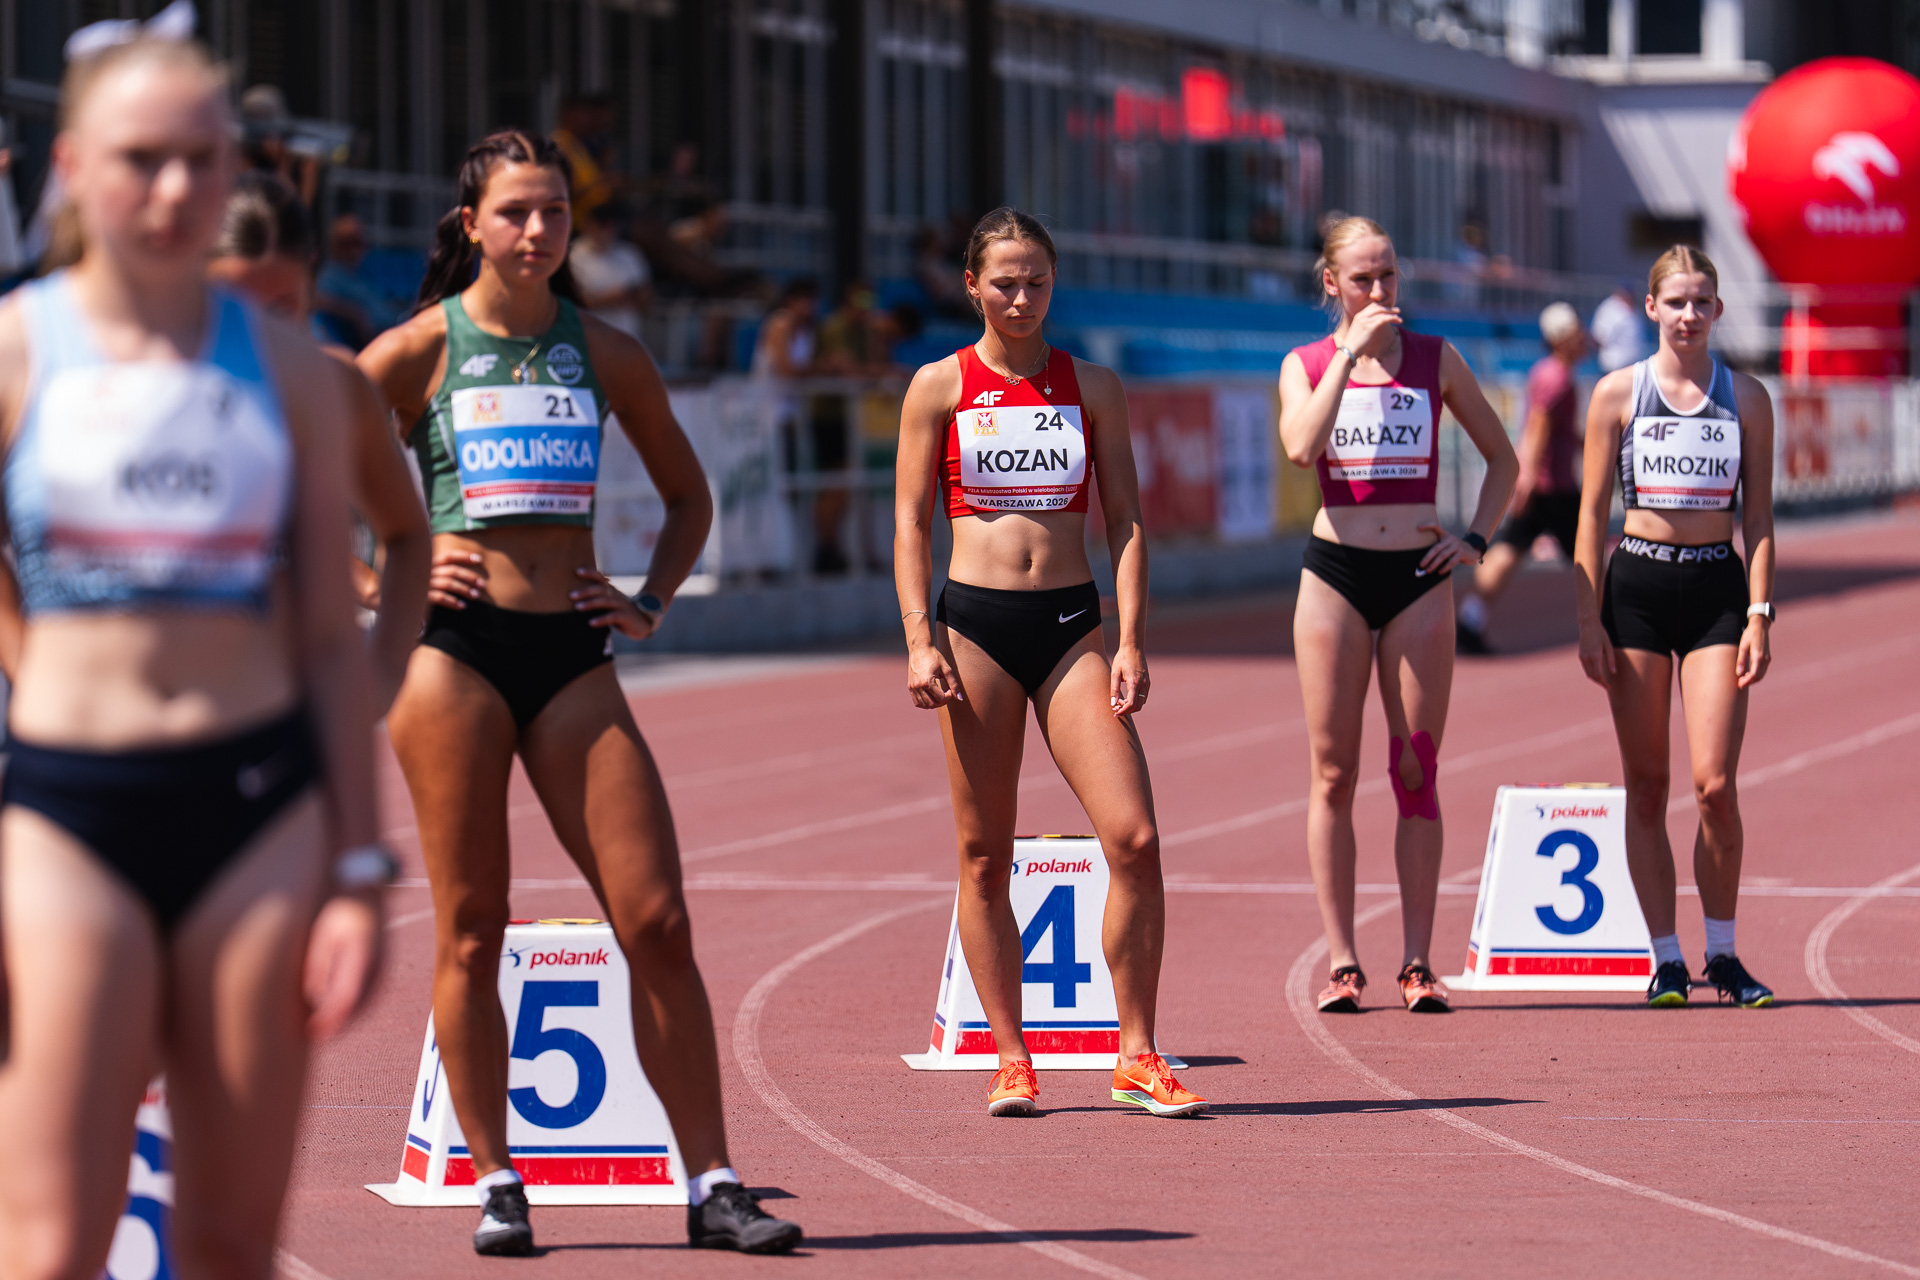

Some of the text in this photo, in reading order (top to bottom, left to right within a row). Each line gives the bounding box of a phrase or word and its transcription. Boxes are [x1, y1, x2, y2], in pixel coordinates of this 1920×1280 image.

[459, 353, 499, 377] 4F
[545, 394, 577, 418] 21
[972, 391, 1004, 406] 4F
[1390, 394, 1414, 410] 29
[1034, 411, 1064, 431] 24
[1641, 422, 1680, 441] 4F
[1335, 424, 1422, 446] BAŁAZY
[1701, 424, 1725, 442] 36
[461, 432, 594, 472] ODOLIŃSKA
[976, 448, 1069, 473] KOZAN
[1643, 454, 1730, 478] MROZIK
[1012, 486, 1028, 494] Polski
[977, 497, 1069, 508] WARSZAWA 2026
[1619, 536, 1729, 564] NIKE PRO
[1551, 804, 1610, 821] polanik
[1026, 858, 1093, 877] polanik
[1534, 829, 1605, 936] 3
[1020, 885, 1092, 1009] 4
[529, 948, 610, 970] polanik
[507, 980, 607, 1130] 5
